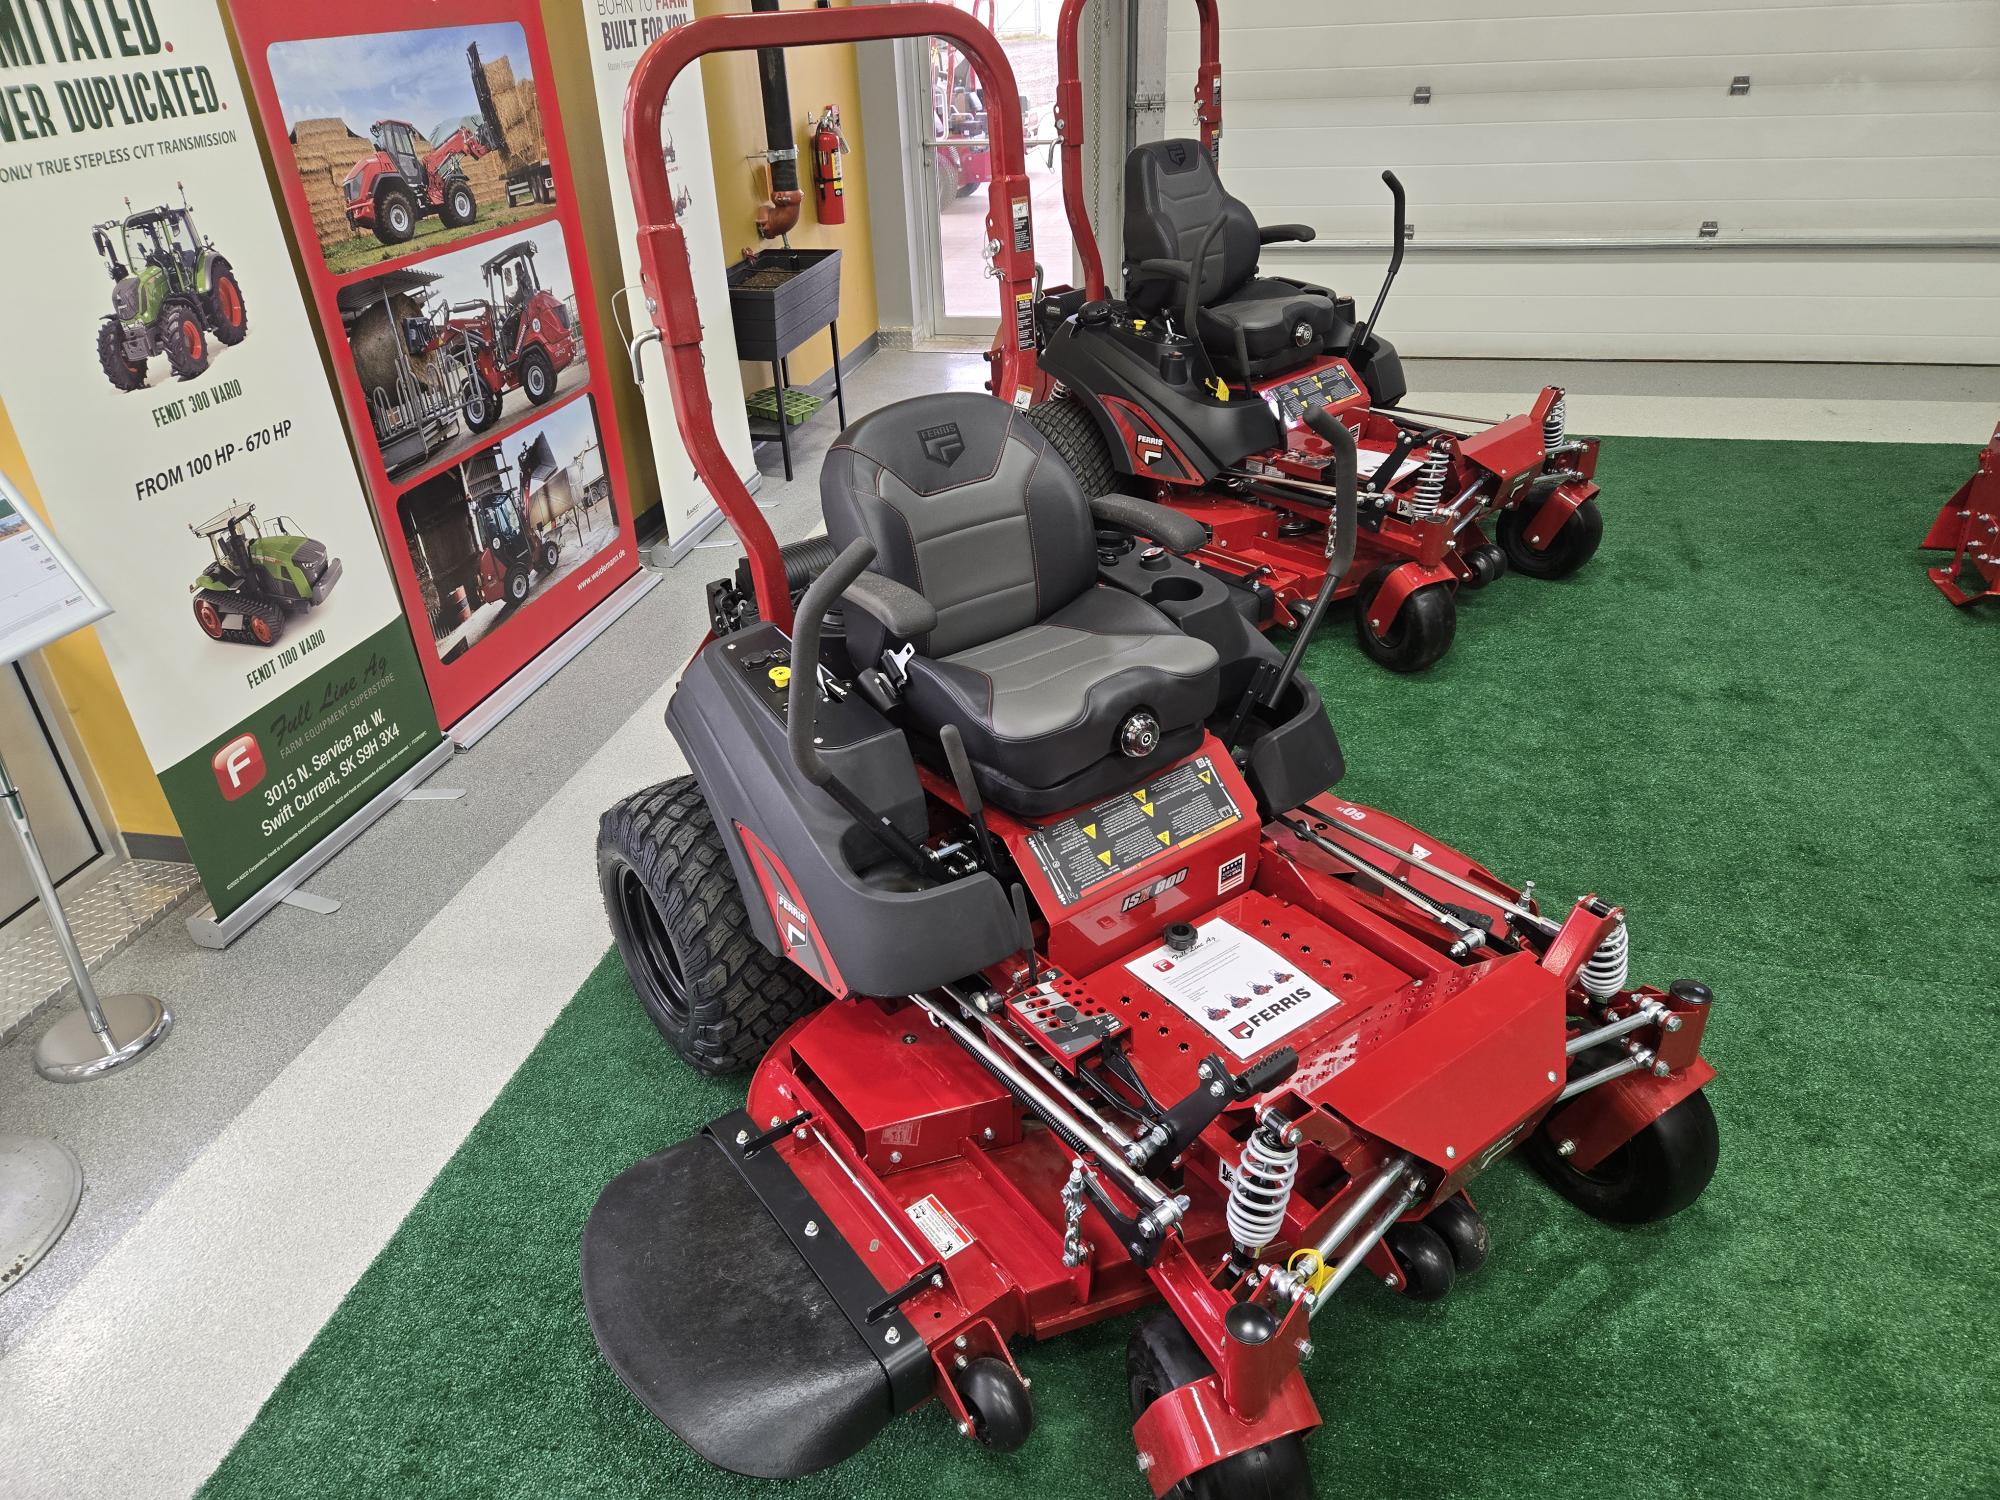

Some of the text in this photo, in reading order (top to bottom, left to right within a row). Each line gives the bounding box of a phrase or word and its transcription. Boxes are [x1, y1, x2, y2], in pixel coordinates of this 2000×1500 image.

[601, 19, 637, 51] BUILT
[54, 65, 227, 134] DUPLICATED.
[0, 129, 237, 183] ONLY TRUE STEPLESS CVT TRANSMISSION
[151, 378, 243, 429] FENDT 300 VARIO
[920, 423, 957, 440] FERRIS
[1137, 434, 1164, 446] FERRIS
[135, 465, 185, 501] FROM
[186, 453, 214, 479] 100
[214, 443, 236, 467] HP
[245, 428, 272, 453] 670
[273, 419, 293, 442] HP
[246, 629, 327, 690] FENDT 1100 VARIO
[270, 652, 387, 747] Full Line Ag
[280, 671, 396, 760] FARM EQUIPMENT SUPERSTORE
[261, 803, 295, 837] Swift
[293, 772, 341, 813] Current,
[339, 755, 358, 777] SK
[355, 737, 380, 765] S9H
[378, 722, 401, 747] 3X4
[263, 708, 386, 807] 3015 N. Service Rd. W.
[1154, 868, 1188, 895] 800
[778, 894, 807, 925] FERRIS
[1250, 989, 1312, 1028] FERRIS
